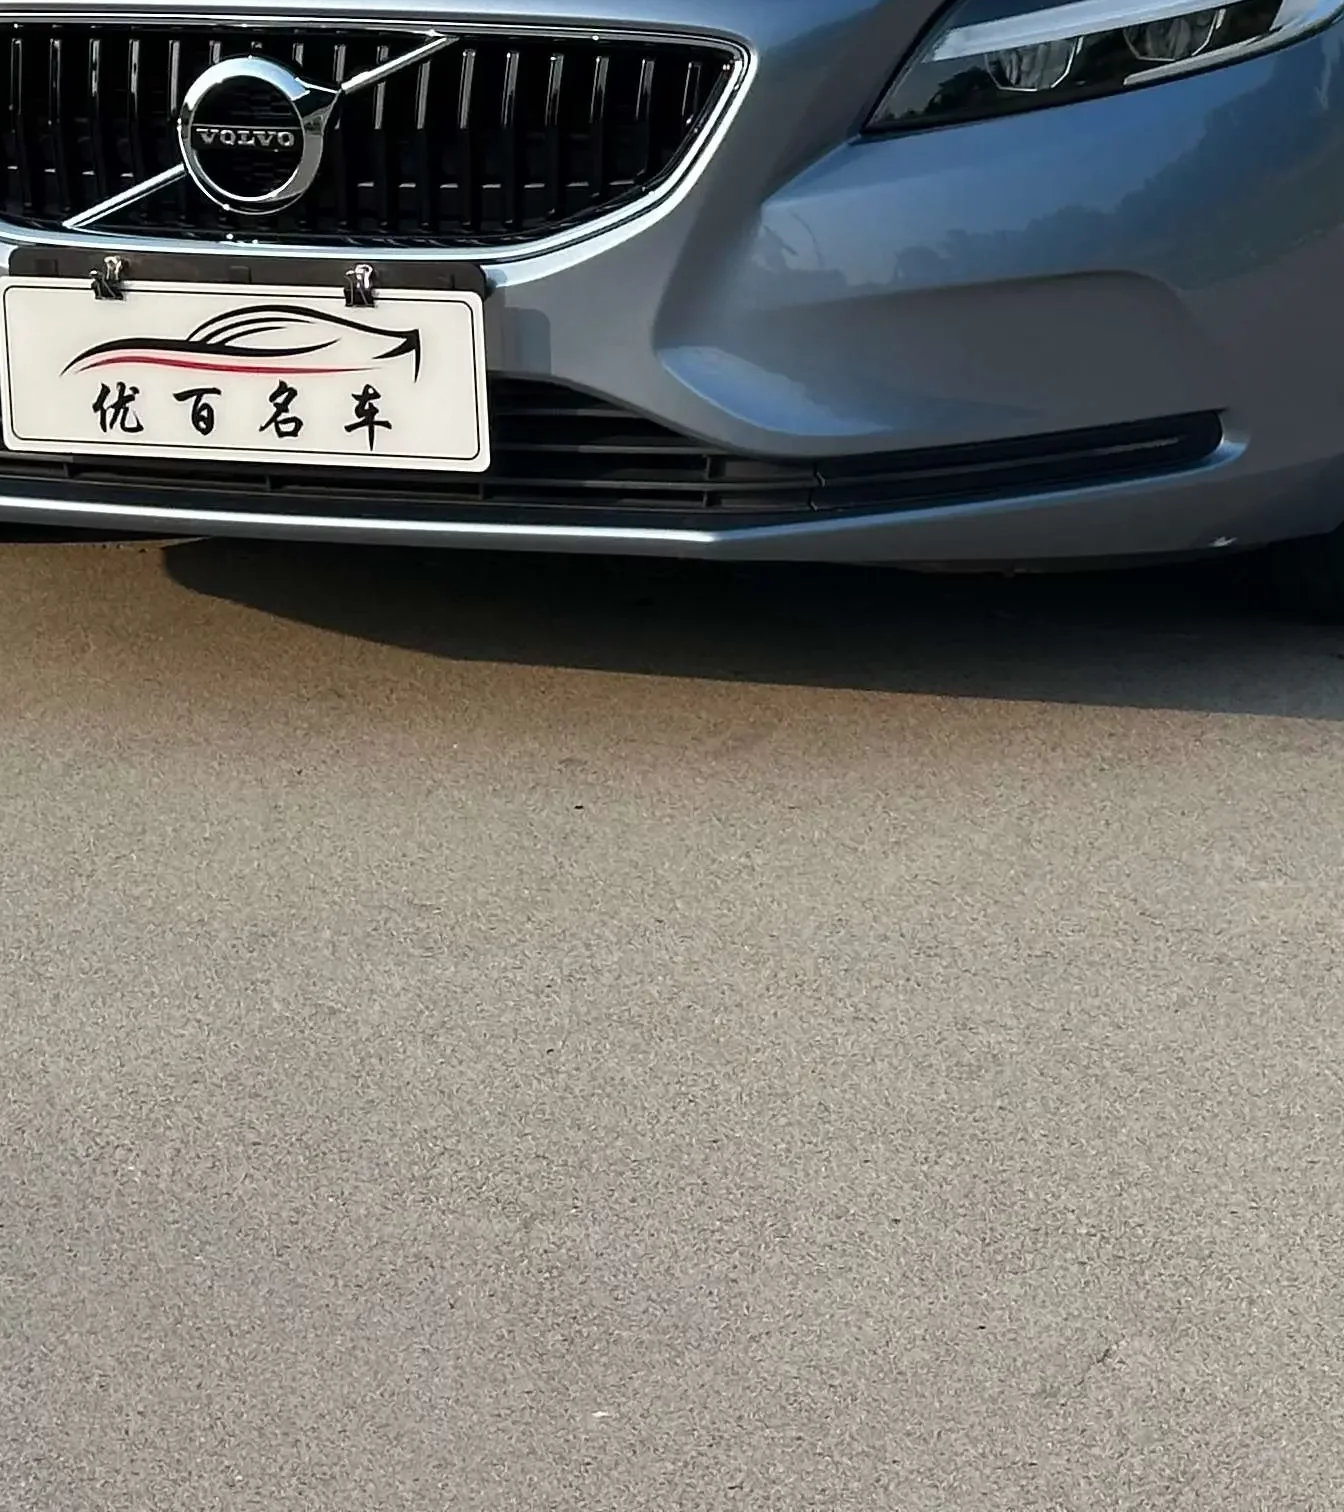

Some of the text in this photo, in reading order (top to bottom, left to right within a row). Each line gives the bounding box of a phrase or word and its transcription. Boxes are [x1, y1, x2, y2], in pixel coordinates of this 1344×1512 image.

[195, 127, 296, 147] VOLVO
[90, 380, 393, 452] 优百名车
